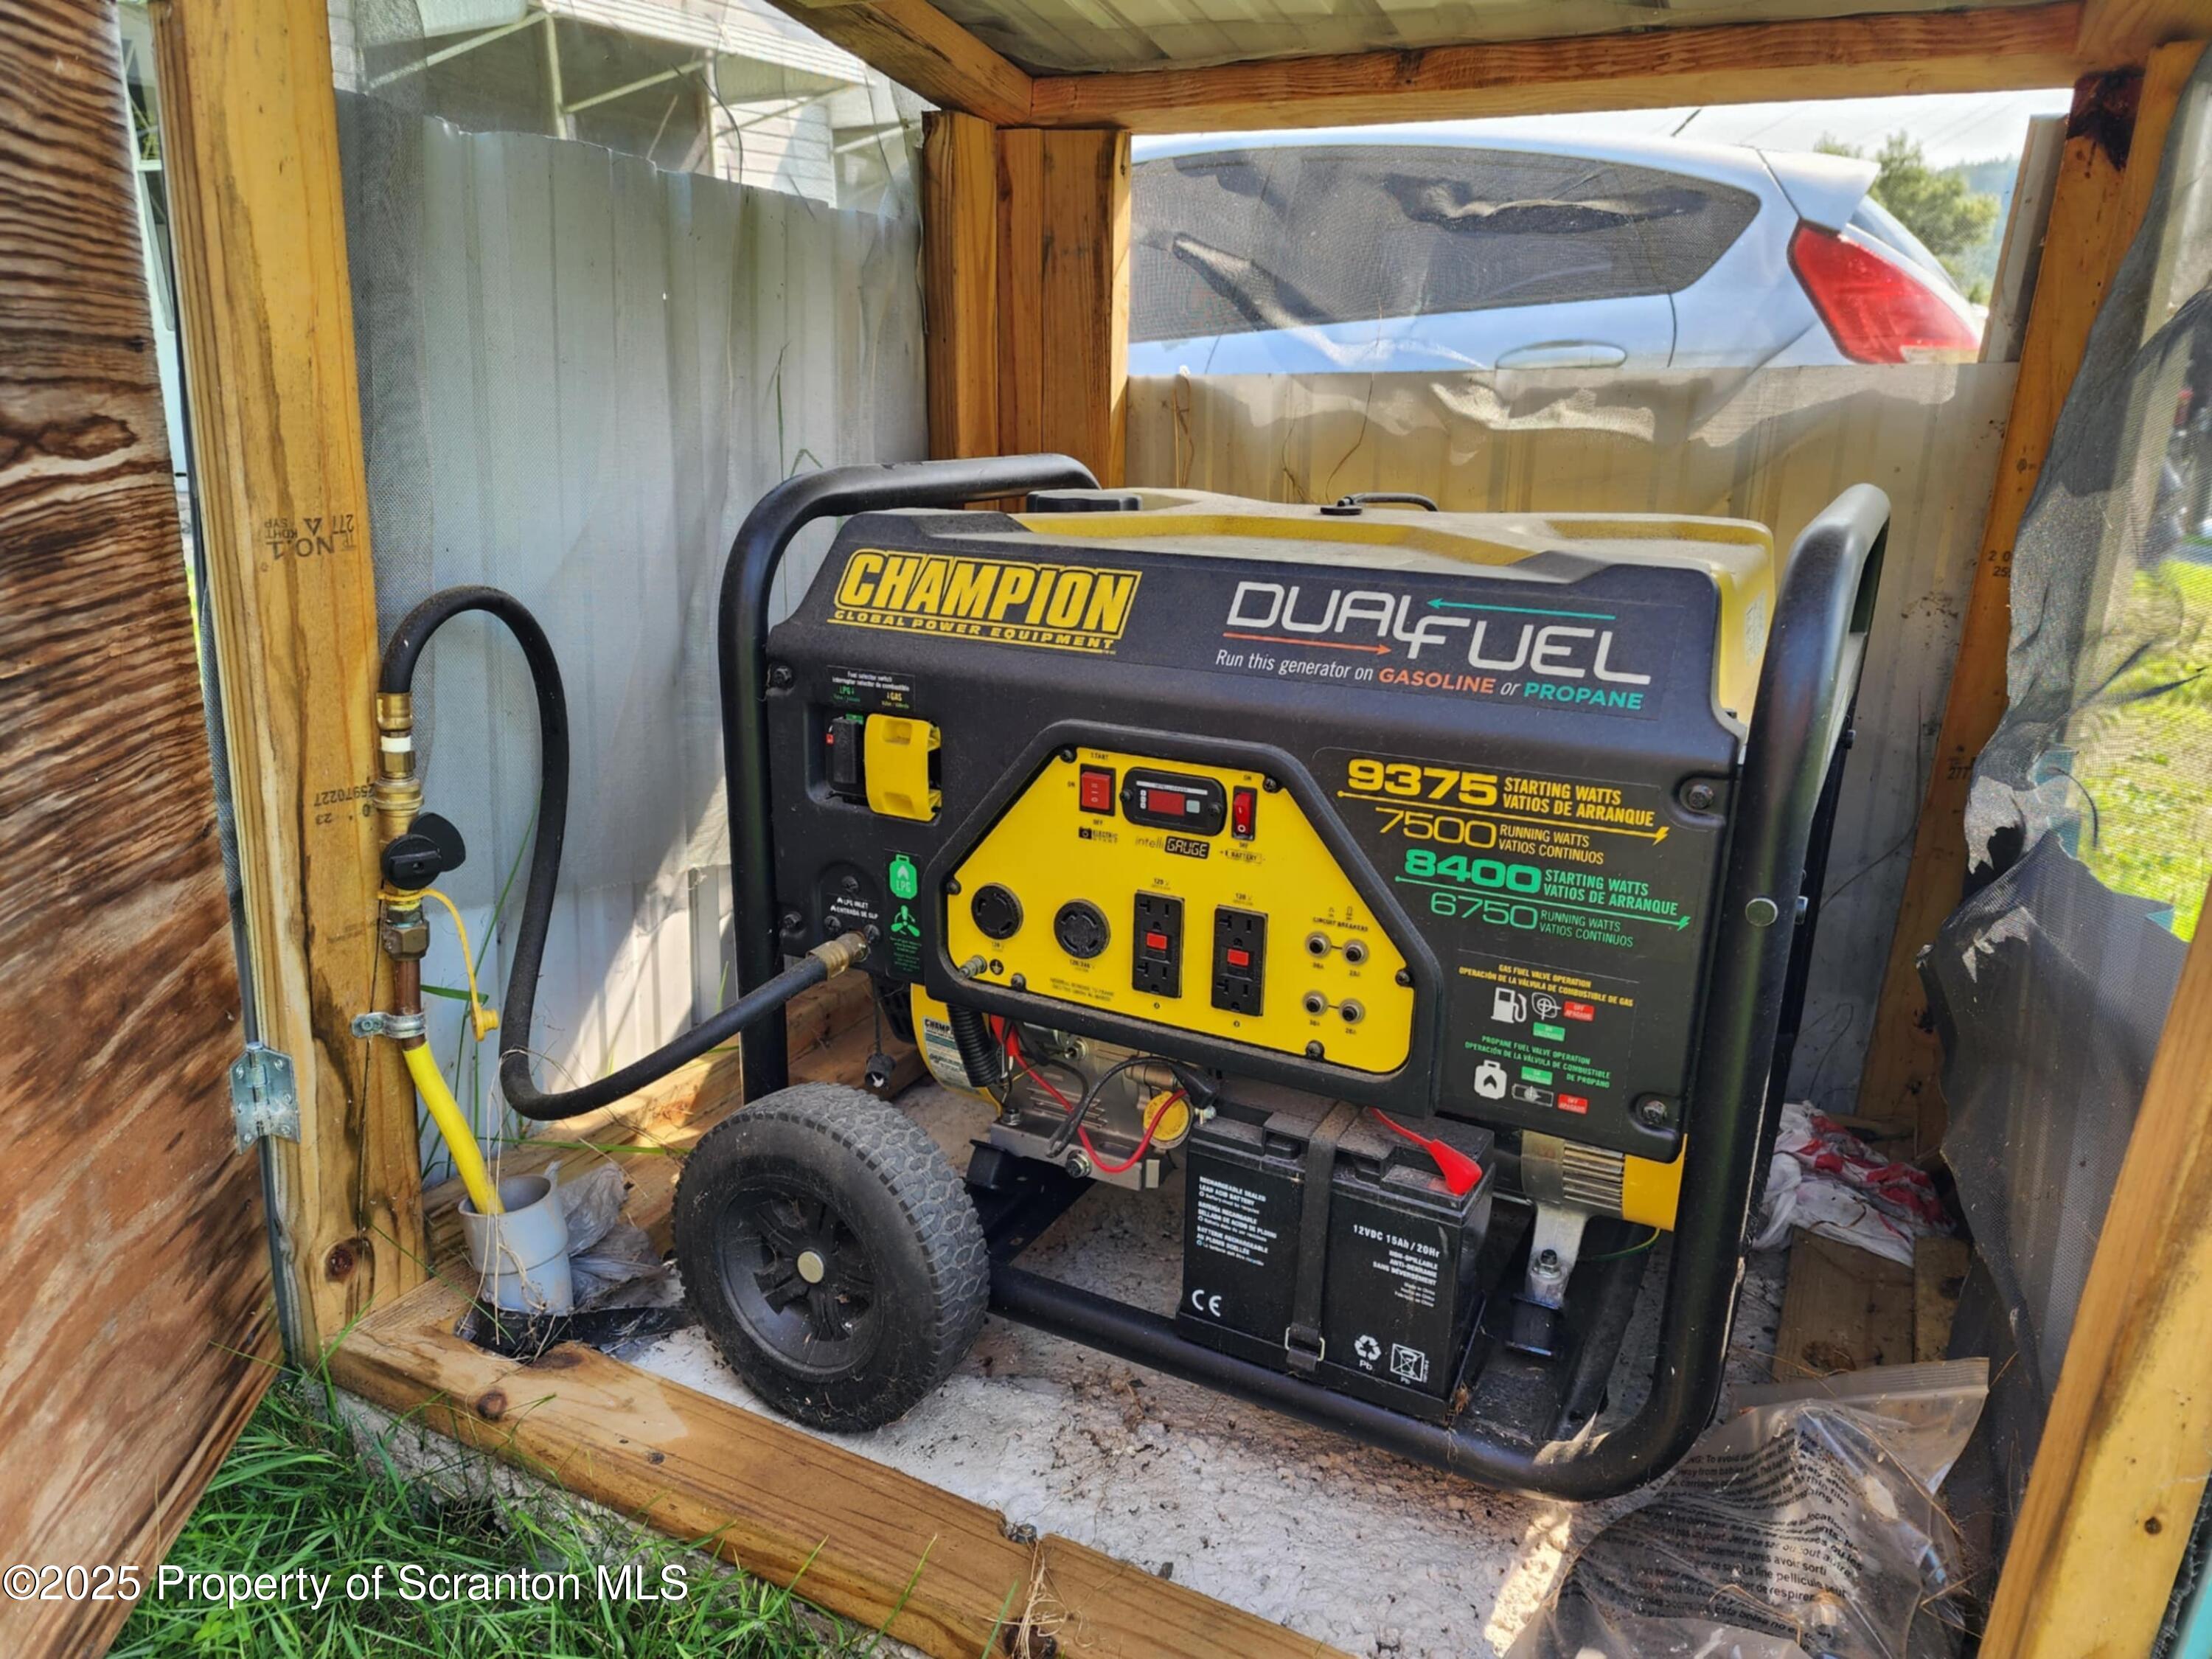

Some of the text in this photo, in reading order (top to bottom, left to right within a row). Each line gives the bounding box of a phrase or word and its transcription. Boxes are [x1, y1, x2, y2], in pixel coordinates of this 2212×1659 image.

[838, 553, 1138, 633] CHAMPION
[834, 611, 1114, 650] GLOBAL POWER EQUIPMENT
[1217, 649, 1644, 711] Run this generator on GASOLINE or PROPANE
[1348, 758, 1498, 807] 9375
[1504, 776, 1622, 805] STARTING WATTS
[1503, 793, 1655, 827] VATIOS DE ARRANQUE
[1375, 806, 1497, 849] 7500
[1500, 824, 1590, 848] RUNNING WATTS
[1498, 838, 1604, 866] VATIOS CONTINUOS
[1405, 848, 1542, 894] 8400
[1545, 869, 1649, 897] STARTING WATTS
[896, 880, 911, 894] LPG
[1543, 883, 1678, 916] VATIOS DE ARRANQUE
[1430, 891, 1538, 931] 6750
[1540, 909, 1621, 933] RUNNING WATTS
[1540, 922, 1634, 948] VATIOS CONTINUOS
[1458, 967, 1635, 1008] OPERACIÓN DE LA VÁLVULA DE COMBUSTIBLE DE GAS
[1498, 964, 1592, 989] GAS FUEL VALVE OPERATION
[1464, 1041, 1502, 1056] OPERACIÓN
[1503, 1049, 1512, 1059] DE
[1513, 1051, 1523, 1061] LA
[1523, 1052, 1551, 1067] VÁLVULA
[1551, 1060, 1562, 1069] DE
[1562, 1062, 1611, 1079] COMBUSTIBLE
[1481, 1036, 1591, 1065] PROPANE FUEL VALVE OPERATION
[1566, 1073, 1610, 1089] DE PROPANO
[1352, 1224, 1383, 1242] 12VDC
[1386, 1234, 1409, 1251] 15Ah
[1416, 1242, 1440, 1259] 20Hr
[1360, 1359, 1373, 1371] Pb
[1775, 1570, 1823, 1590] pellicule
[1801, 1561, 1828, 1576] sorti
